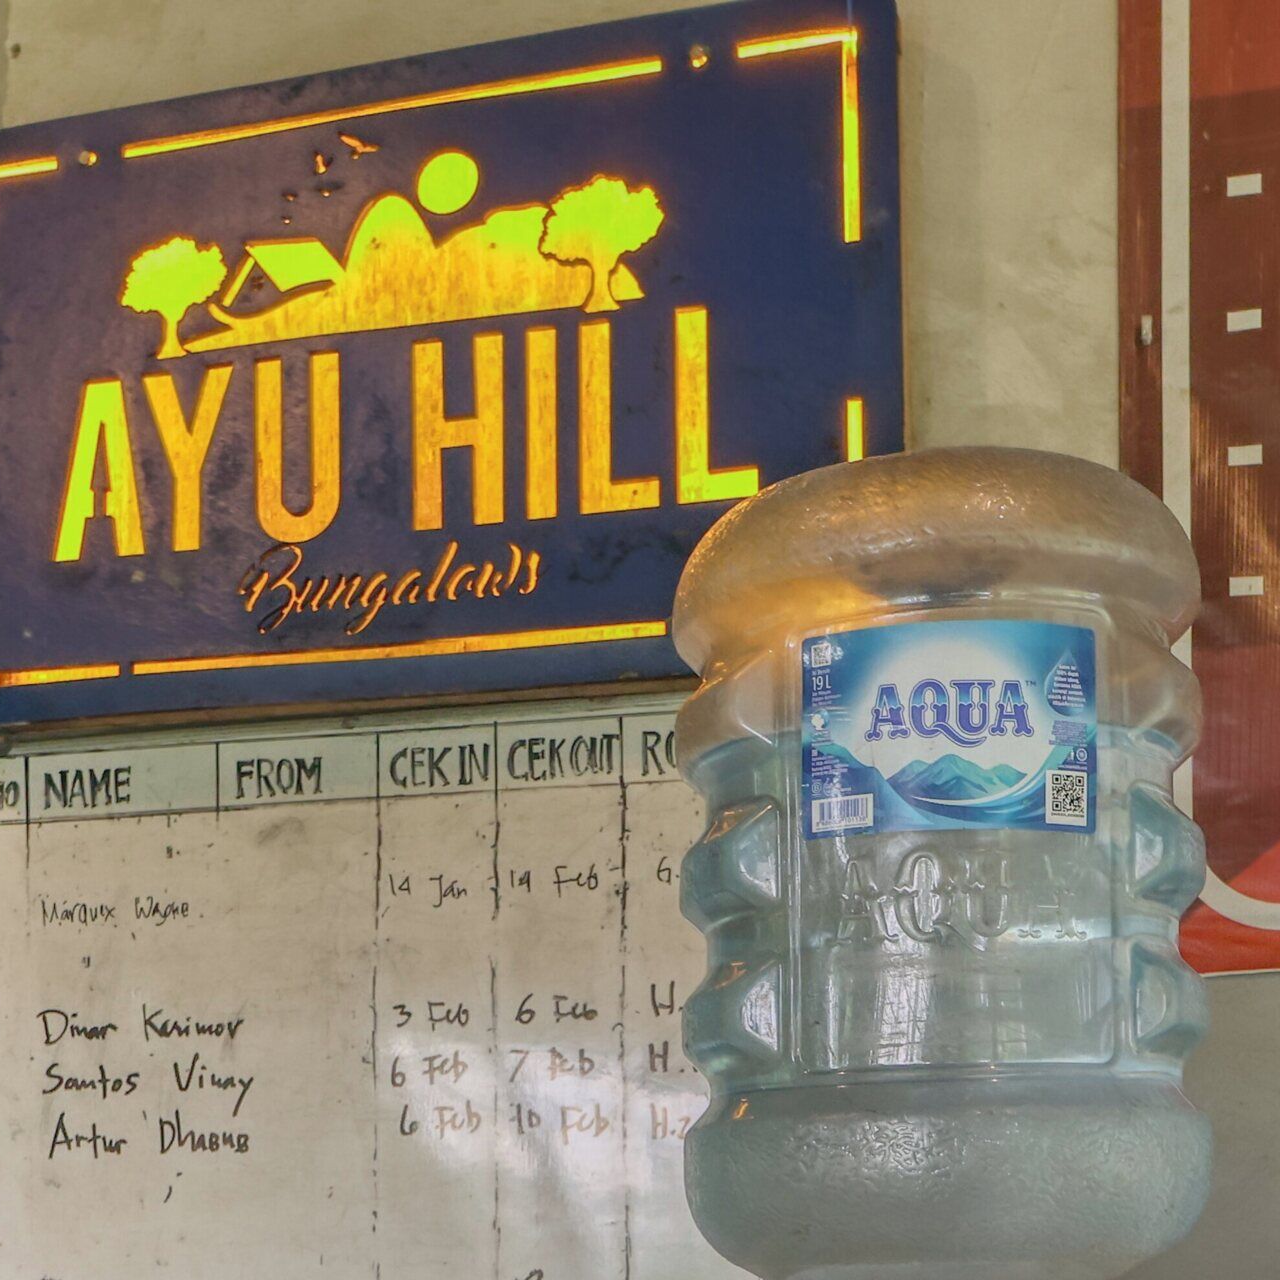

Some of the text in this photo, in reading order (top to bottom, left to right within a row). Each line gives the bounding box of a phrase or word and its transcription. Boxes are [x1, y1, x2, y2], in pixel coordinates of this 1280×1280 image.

[54, 306, 760, 562] AYU HILL
[812, 675, 824, 691] 19
[864, 678, 1035, 748] AQUA
[236, 756, 323, 799] FROM
[389, 746, 450, 788] CEK
[43, 766, 131, 810] NAME
[429, 874, 467, 908] Jan
[553, 863, 598, 898] Feb
[393, 1001, 470, 1032] 3 Feb
[515, 993, 598, 1024] 6 Feb
[42, 1062, 140, 1100] Santos
[391, 1051, 468, 1088] 6 Feb
[49, 1112, 128, 1159] Artur
[400, 1100, 482, 1140] 6 Feb
[560, 1103, 610, 1145] Feb
